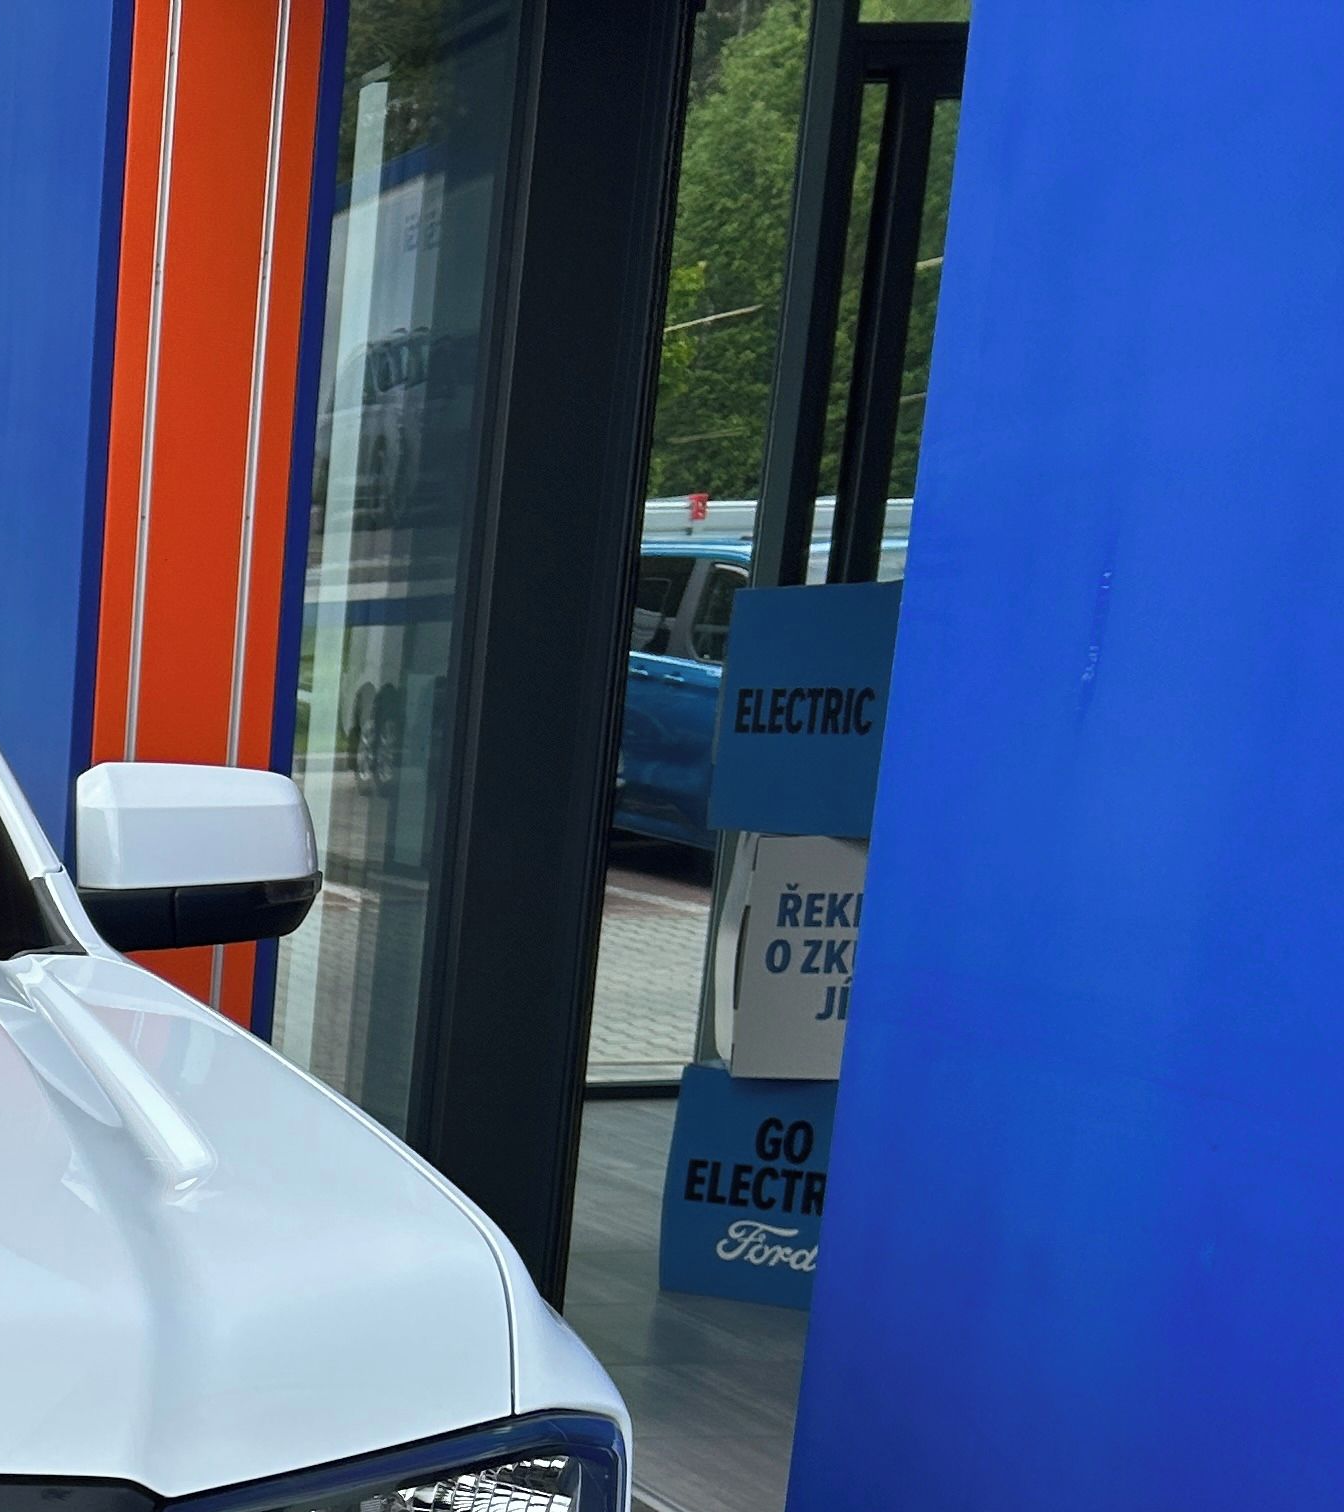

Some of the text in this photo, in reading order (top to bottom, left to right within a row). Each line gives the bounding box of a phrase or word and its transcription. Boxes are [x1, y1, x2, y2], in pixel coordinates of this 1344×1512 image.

[734, 687, 876, 735] ELECTRIC
[765, 938, 857, 974] O ZK
[756, 1117, 814, 1165] GO
[684, 1158, 827, 1216] ELECTR
[716, 1220, 819, 1272] Ford
